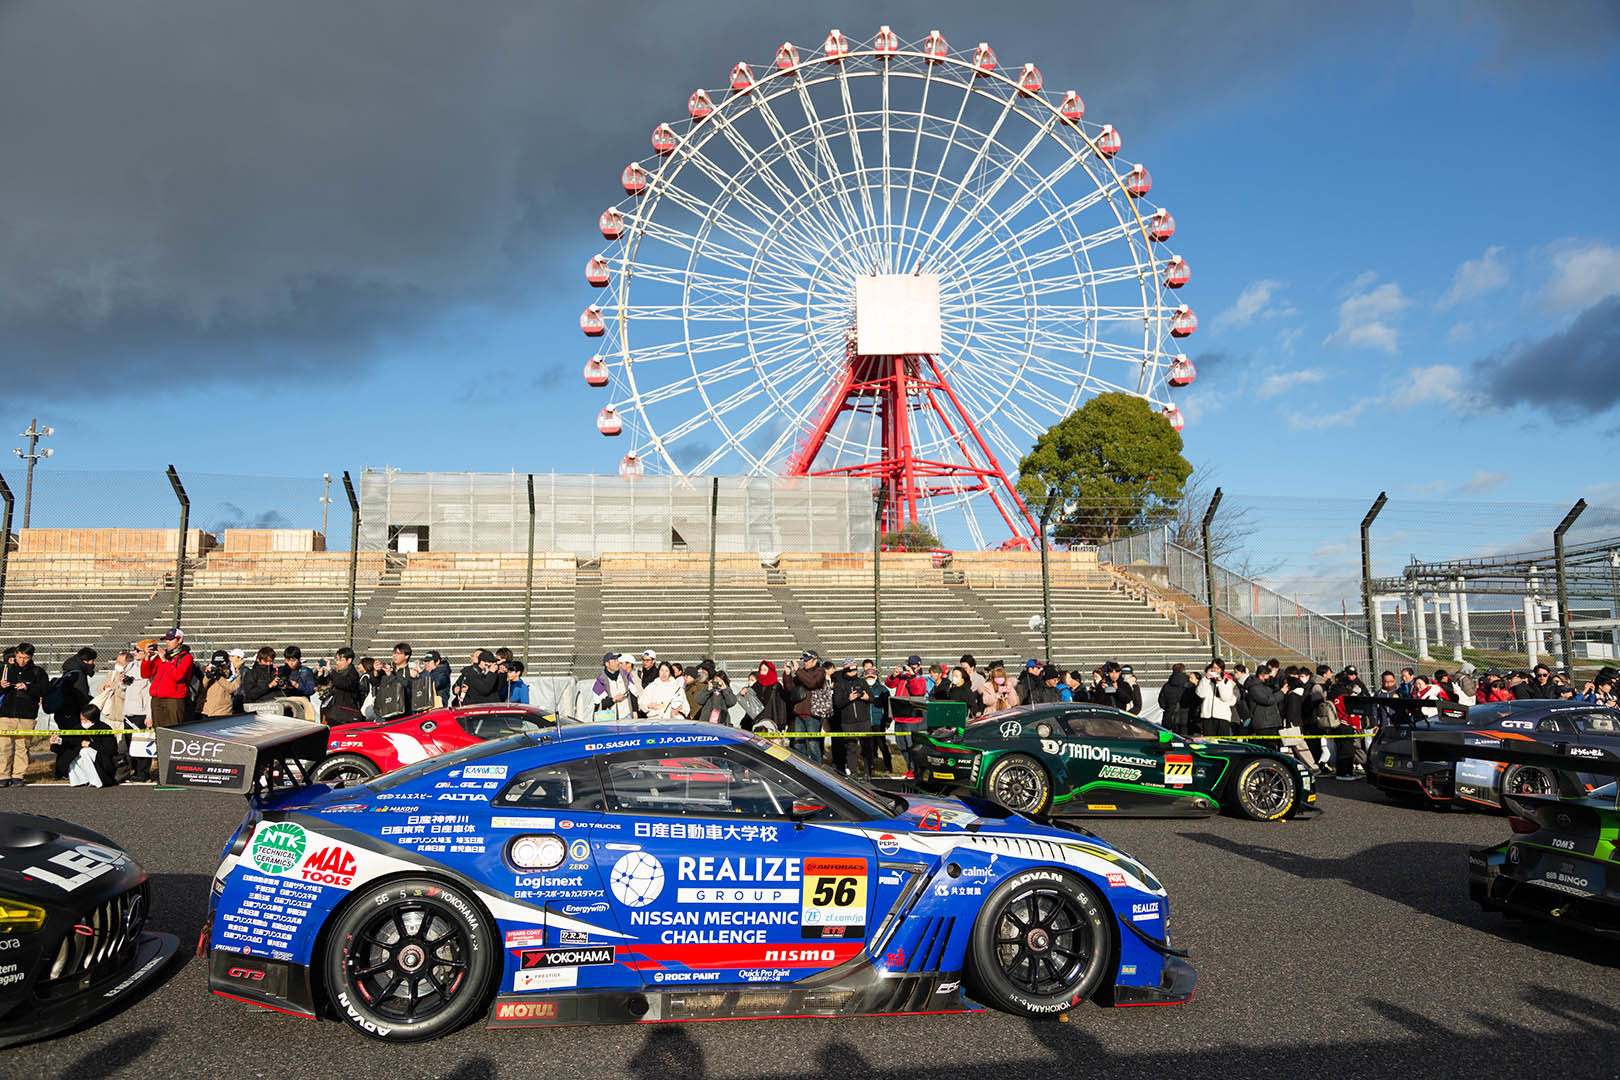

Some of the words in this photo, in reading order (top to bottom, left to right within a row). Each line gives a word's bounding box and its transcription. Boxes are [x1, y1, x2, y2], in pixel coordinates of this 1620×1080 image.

[1501, 720, 1533, 730] GT3
[595, 739, 641, 750] D.SASAKI
[659, 735, 720, 745] J.P.OLIVEIRA
[1111, 754, 1157, 767] RACING
[1098, 765, 1142, 781] NEXUS
[1166, 763, 1192, 775] 777
[437, 793, 489, 802] ALTIA
[407, 815, 470, 825] 日産神奈川
[589, 822, 622, 830] TRUCKS
[381, 825, 425, 835] 日産東京
[430, 824, 476, 834] 日産車体
[634, 822, 779, 843] 日産自動車大学校
[263, 830, 302, 849] NTK
[398, 836, 452, 844] 日産プリンス埼玉
[258, 846, 296, 860] TECHNICAL
[256, 854, 293, 868] CERAMICS
[303, 846, 357, 877] MAC
[816, 863, 865, 871] AUTOBACS
[678, 856, 801, 882] REALIZE
[301, 869, 353, 887] TOOLS
[515, 875, 583, 889] Logisnext
[1010, 871, 1063, 891] ADVAN
[1558, 873, 1588, 887] BINGO
[375, 893, 390, 906] 56
[400, 889, 407, 899] 5
[696, 890, 783, 901] GROUP
[812, 876, 858, 907] 56
[440, 891, 480, 931] YOKOHAMA
[565, 904, 606, 915] Energywith
[1132, 902, 1160, 914] REALIZE
[630, 911, 699, 926] NISSAN
[703, 911, 799, 925] MECHANIC
[824, 912, 865, 923] zf.com/jp
[660, 930, 767, 944] CHALLENGE
[546, 950, 611, 965] YOKOHAMA
[764, 949, 836, 961] nismo
[228, 966, 266, 981] GT3
[664, 973, 692, 982] ROCK
[692, 971, 721, 981] PAINT
[738, 969, 761, 979] Quick
[760, 969, 772, 978] Pro
[772, 968, 791, 978] Paint
[499, 1004, 555, 1018] MOTUL
[1026, 1000, 1071, 1013] YOKOHAMA
[337, 991, 392, 1037] ADVAN
